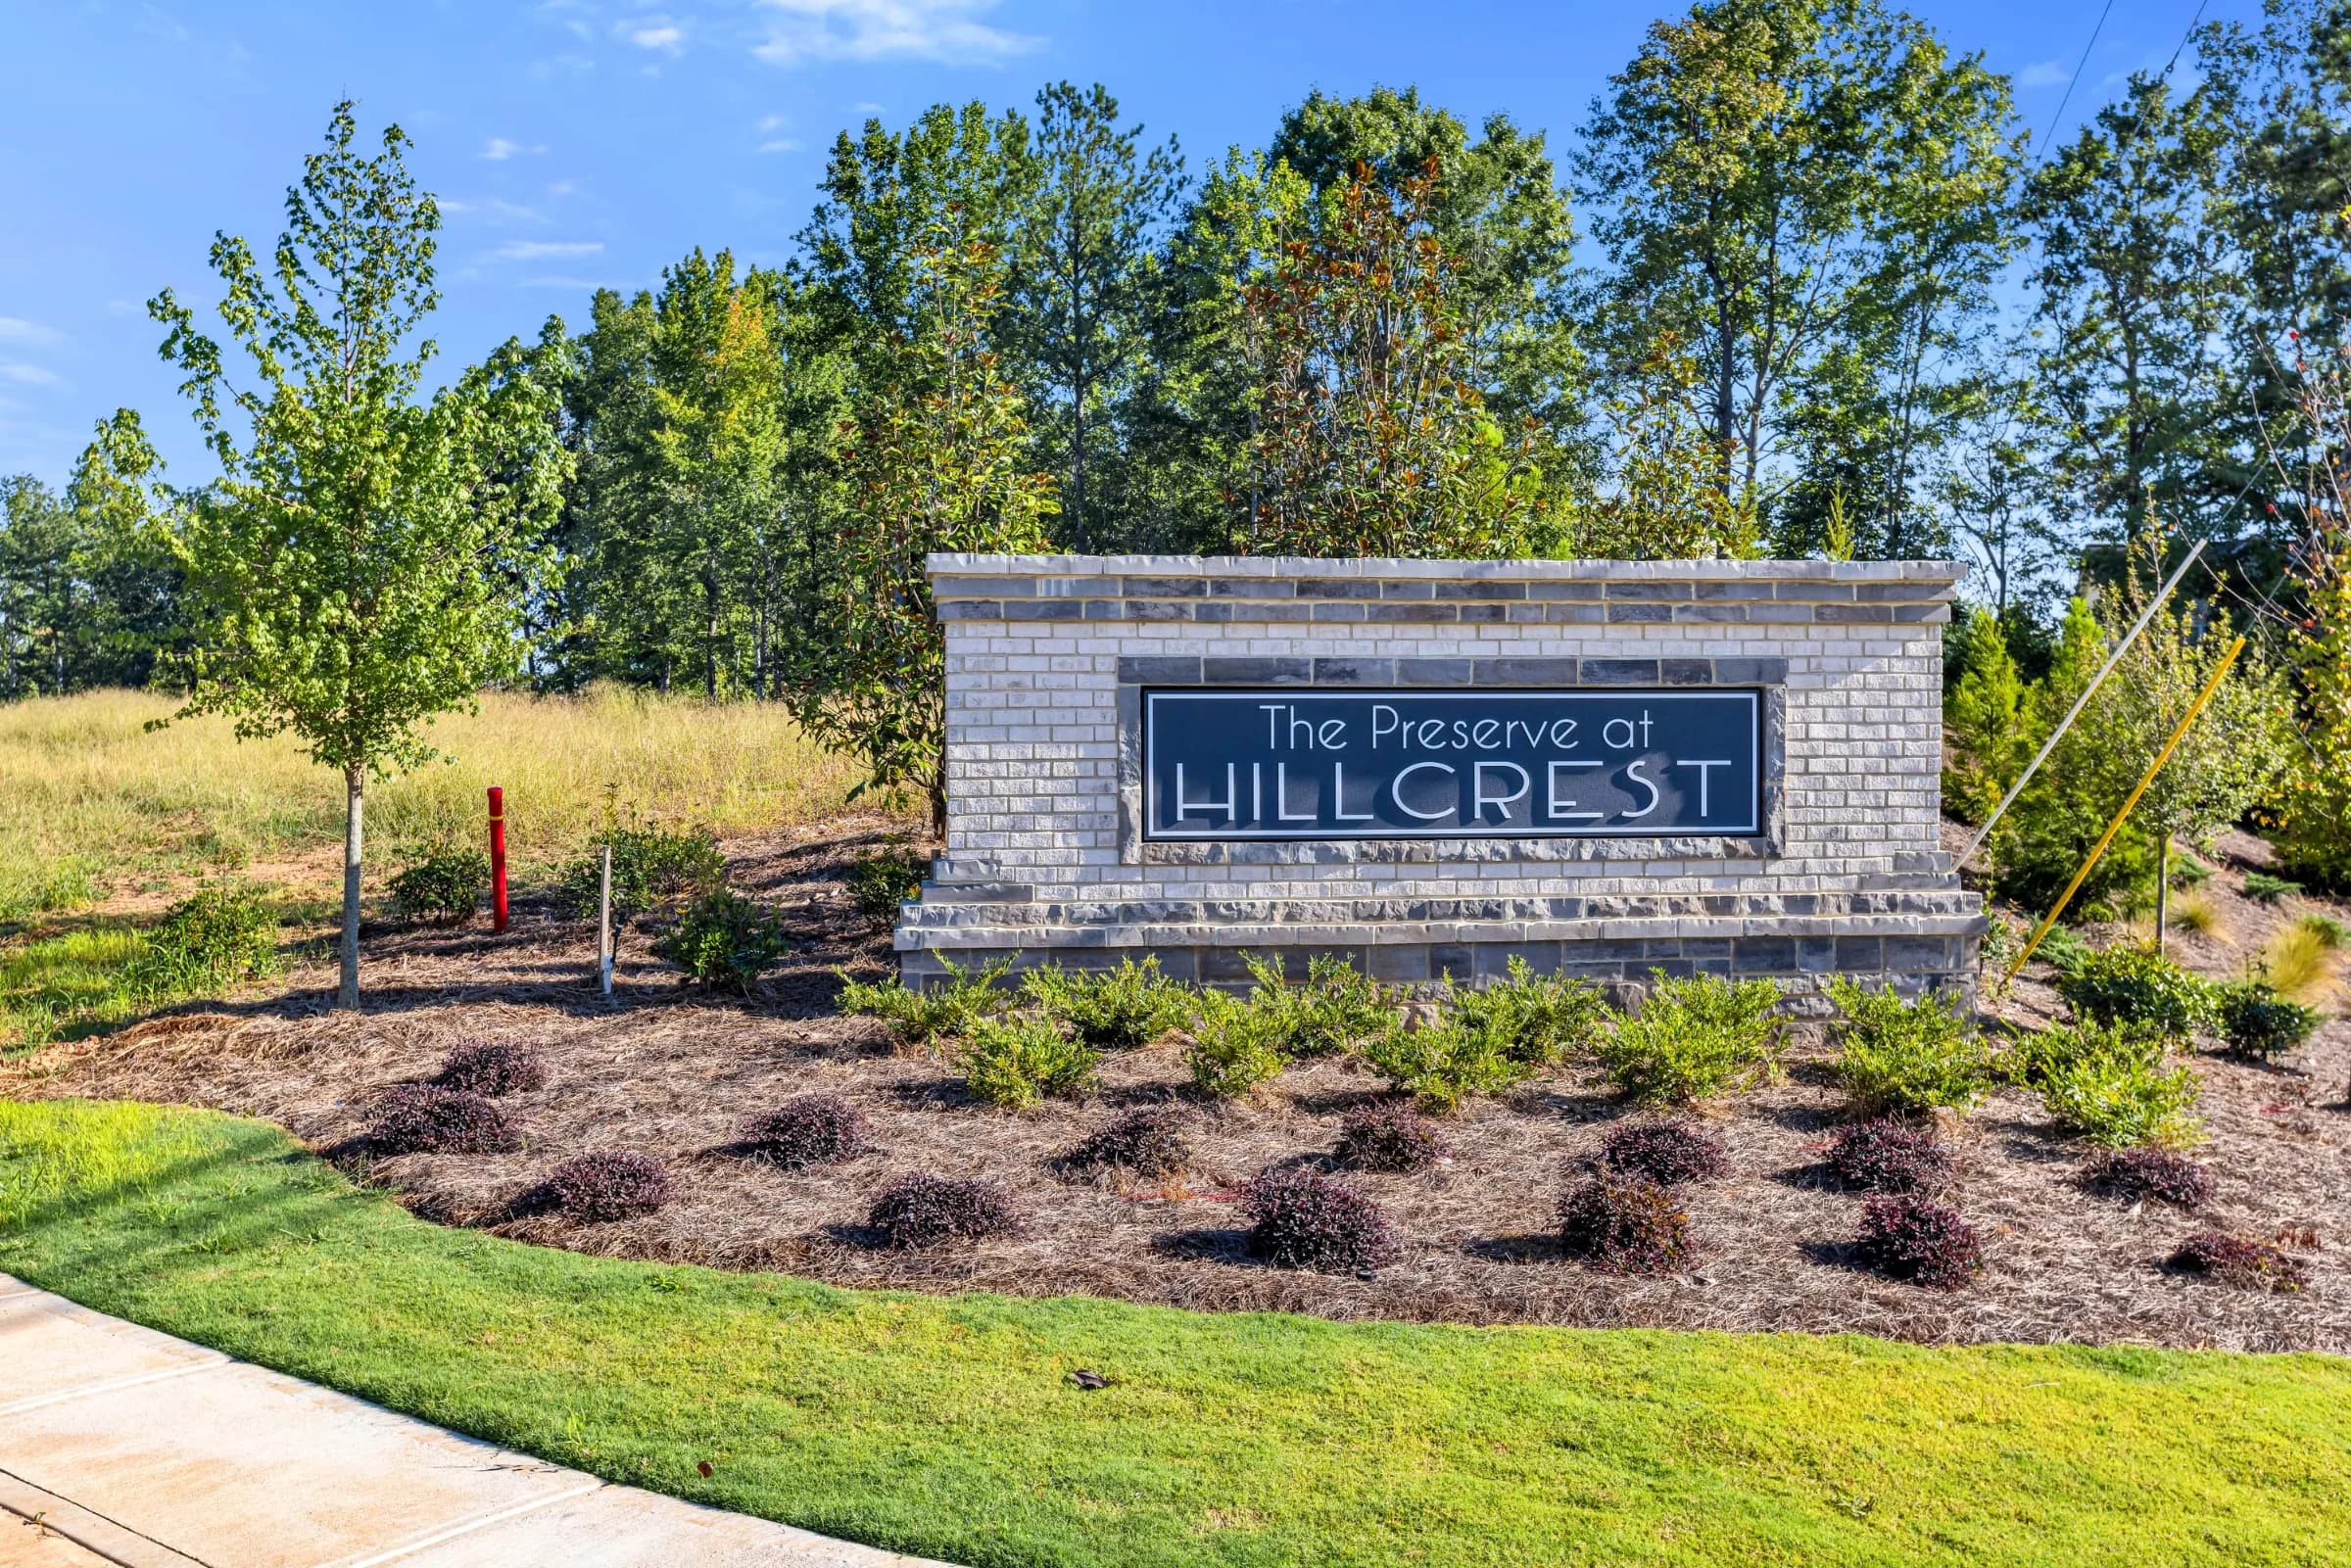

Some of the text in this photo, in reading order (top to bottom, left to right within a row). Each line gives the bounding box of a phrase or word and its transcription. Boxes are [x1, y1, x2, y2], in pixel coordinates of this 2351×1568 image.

[1259, 704, 1655, 750] The Preserve at
[1176, 759, 1733, 822] HILLCREST
